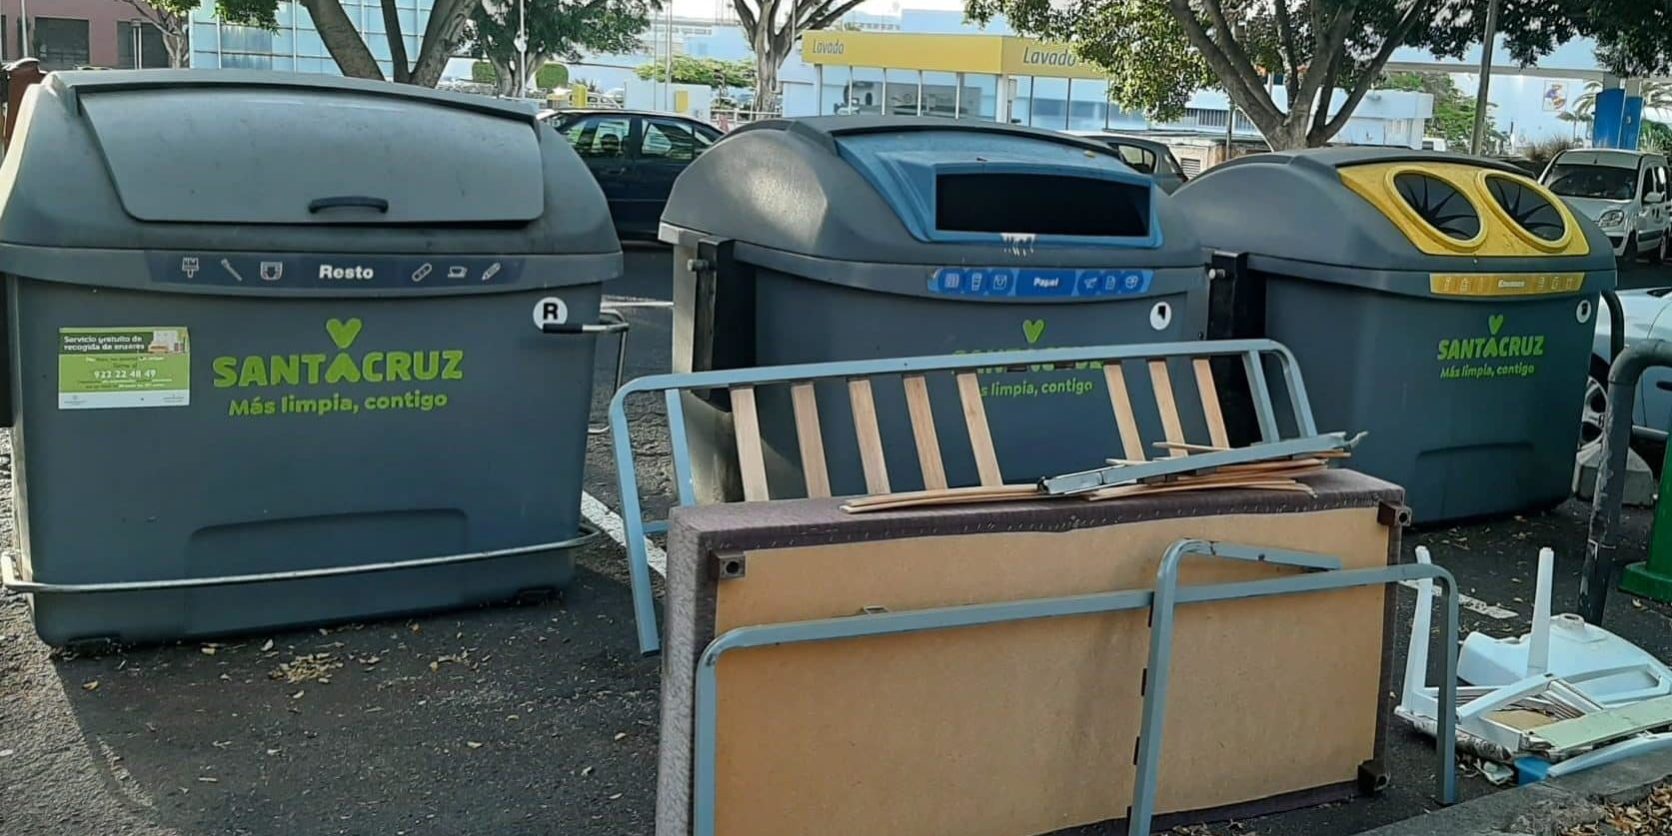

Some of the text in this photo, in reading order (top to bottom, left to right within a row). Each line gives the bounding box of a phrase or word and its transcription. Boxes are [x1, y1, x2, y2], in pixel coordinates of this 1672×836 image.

[812, 39, 845, 55] Lavado
[1023, 46, 1076, 67] Lavado
[319, 264, 374, 280] Resto
[543, 302, 559, 320] R
[63, 343, 100, 352] recogida
[64, 336, 97, 344] Servicio
[115, 370, 127, 378] 22
[1440, 365, 1460, 380] Más
[1496, 362, 1535, 377] contigo
[991, 380, 1038, 396] limpia,
[1041, 377, 1093, 394] contigo
[229, 389, 448, 416] Más limpia, contigo
